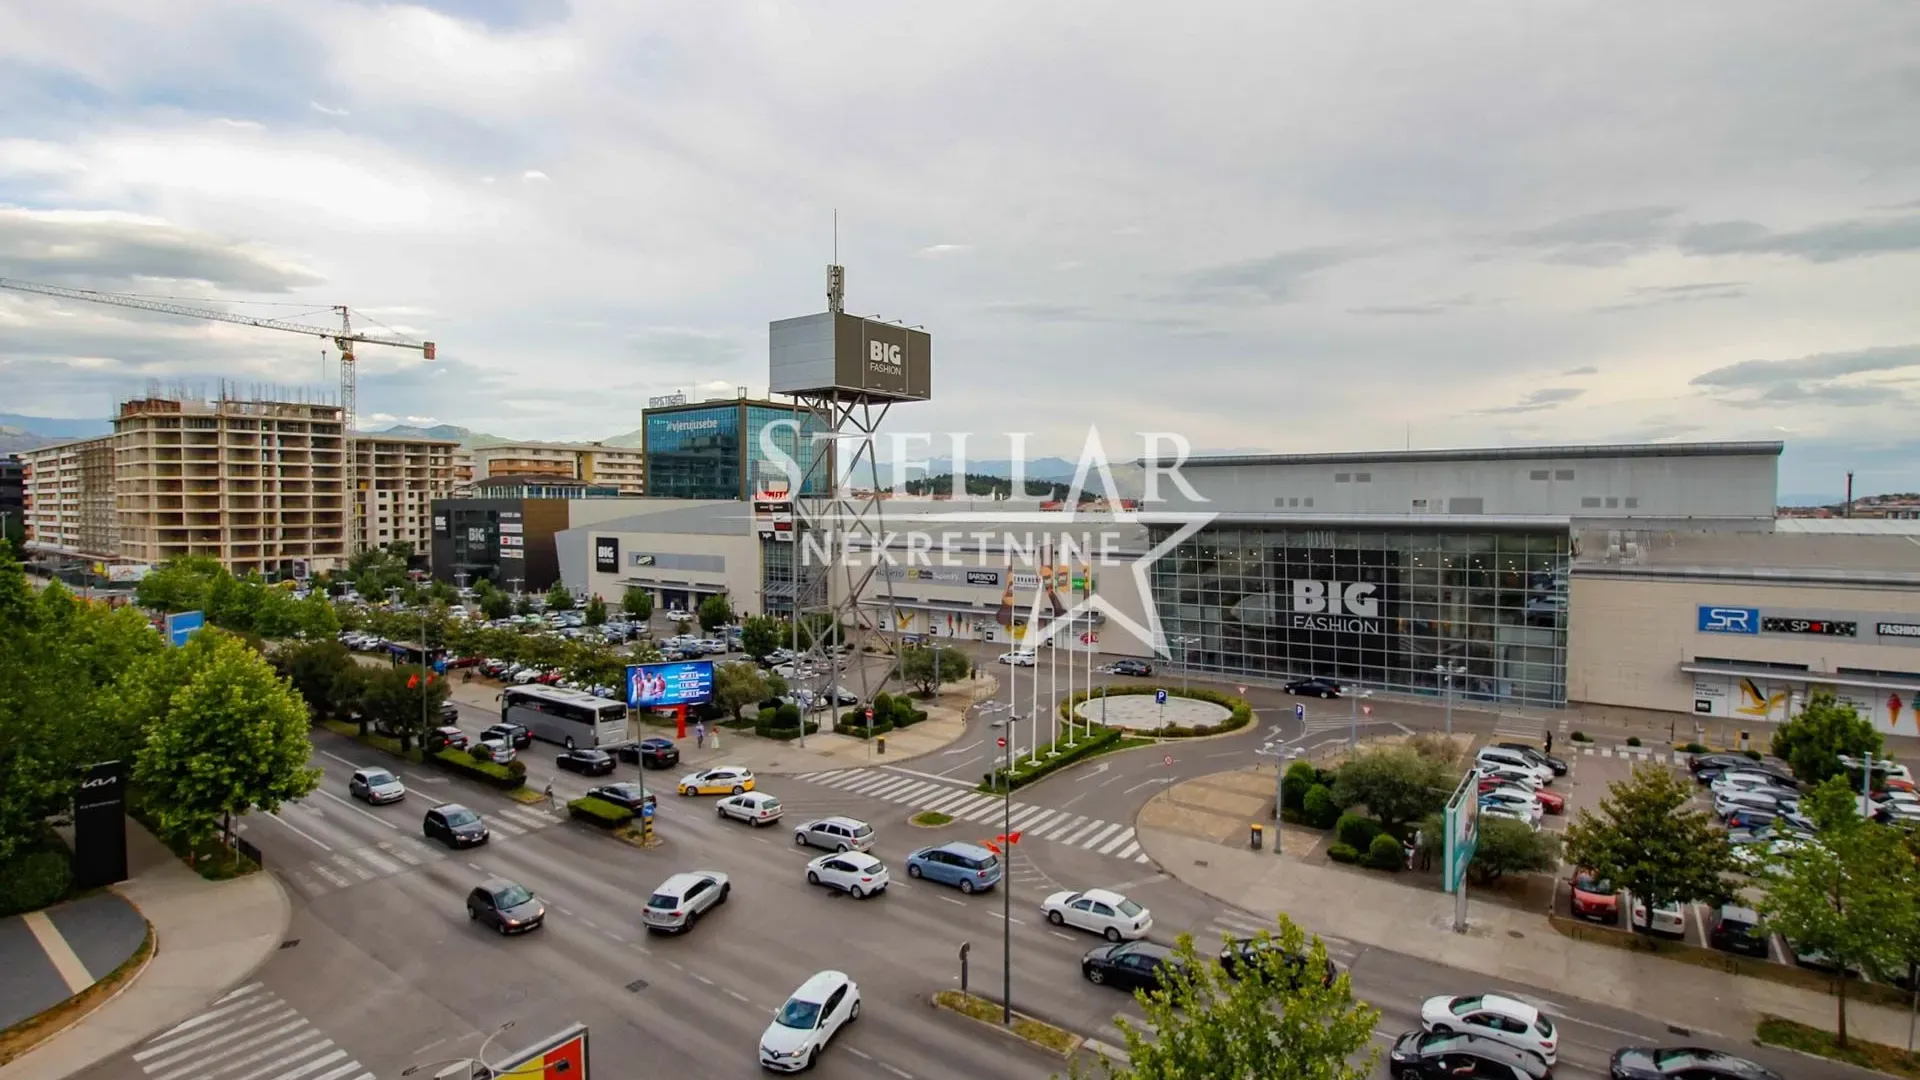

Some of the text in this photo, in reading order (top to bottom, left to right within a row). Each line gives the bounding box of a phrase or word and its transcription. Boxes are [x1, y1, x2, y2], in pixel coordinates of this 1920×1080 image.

[870, 340, 901, 365] BIG
[870, 361, 901, 376] FASHION
[468, 527, 486, 542] BIG
[598, 546, 614, 558] BIG
[1293, 580, 1378, 617] BIG
[1294, 615, 1379, 635] FASHION
[1707, 608, 1748, 629] SR
[1159, 691, 1165, 700] P
[1297, 705, 1302, 714] P
